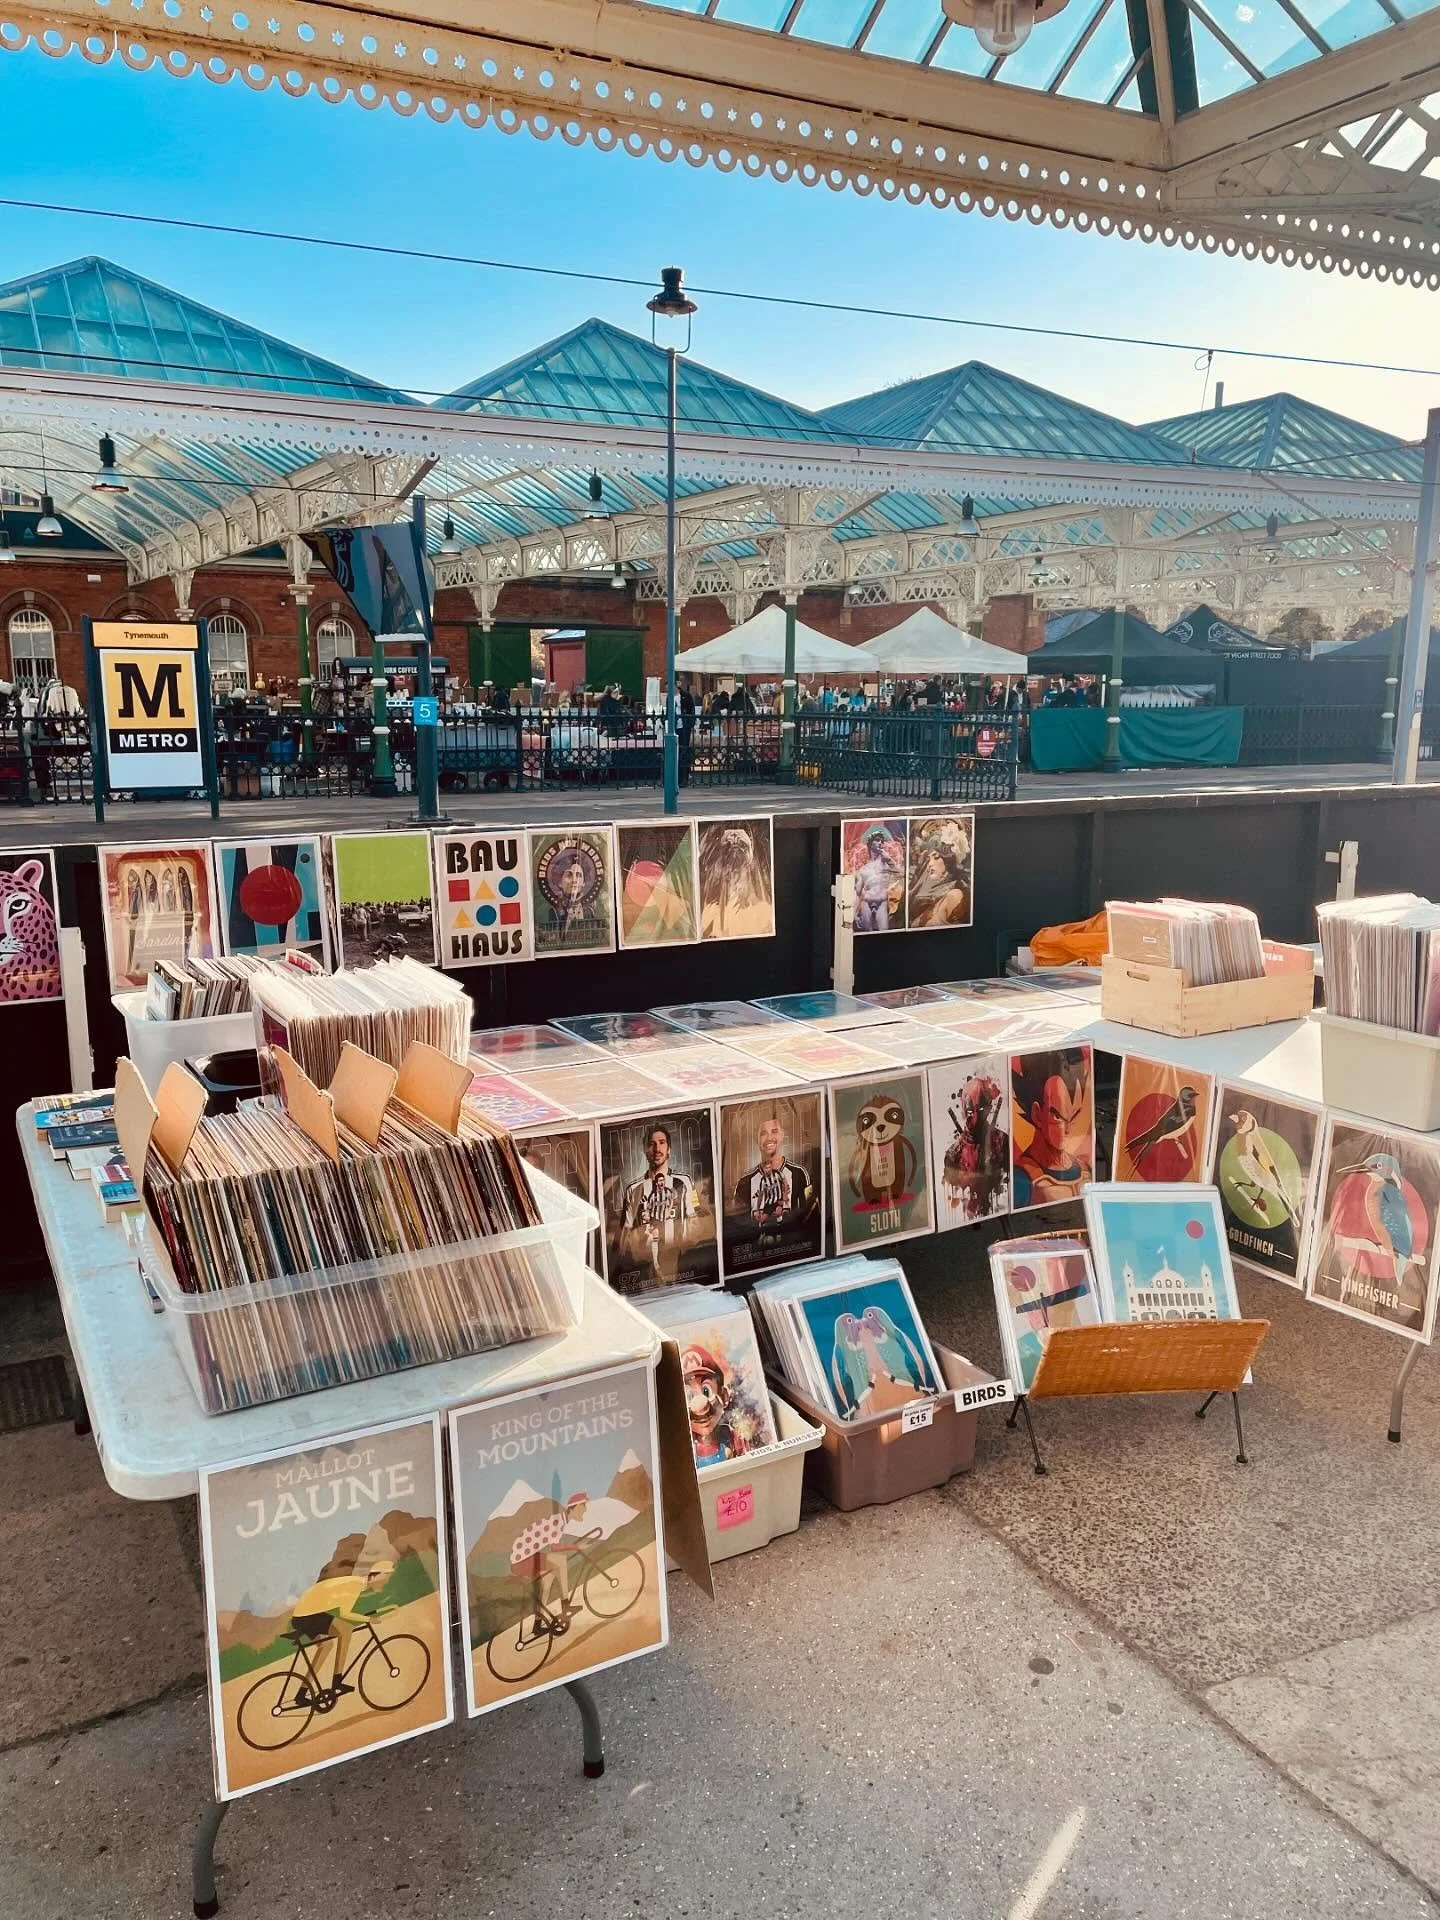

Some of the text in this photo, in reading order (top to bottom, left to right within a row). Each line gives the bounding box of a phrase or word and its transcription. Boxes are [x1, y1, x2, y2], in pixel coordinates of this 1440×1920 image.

[124, 631, 169, 640] Tynemouth
[114, 663, 185, 718] M
[419, 703, 431, 718] 5
[119, 733, 188, 748] METRO
[445, 839, 518, 874] BAU
[538, 847, 557, 878] DEEDS
[581, 842, 604, 876] WORDS
[451, 930, 523, 959] HAUS
[870, 1209, 901, 1233] SLOTH
[1228, 1227, 1275, 1257] GOLDFINCH
[1340, 1276, 1400, 1310] KINGFISHER
[962, 1384, 1007, 1407] BIRDS
[490, 1391, 620, 1441] KING OF THE
[910, 1413, 927, 1426] £15
[477, 1408, 633, 1470] MOUNTAINS
[750, 1447, 773, 1457] KIDS
[783, 1430, 824, 1448] NURSERY
[275, 1448, 376, 1489] MAILLOT
[235, 1461, 416, 1539] JAUNE
[726, 1500, 748, 1517] £10
